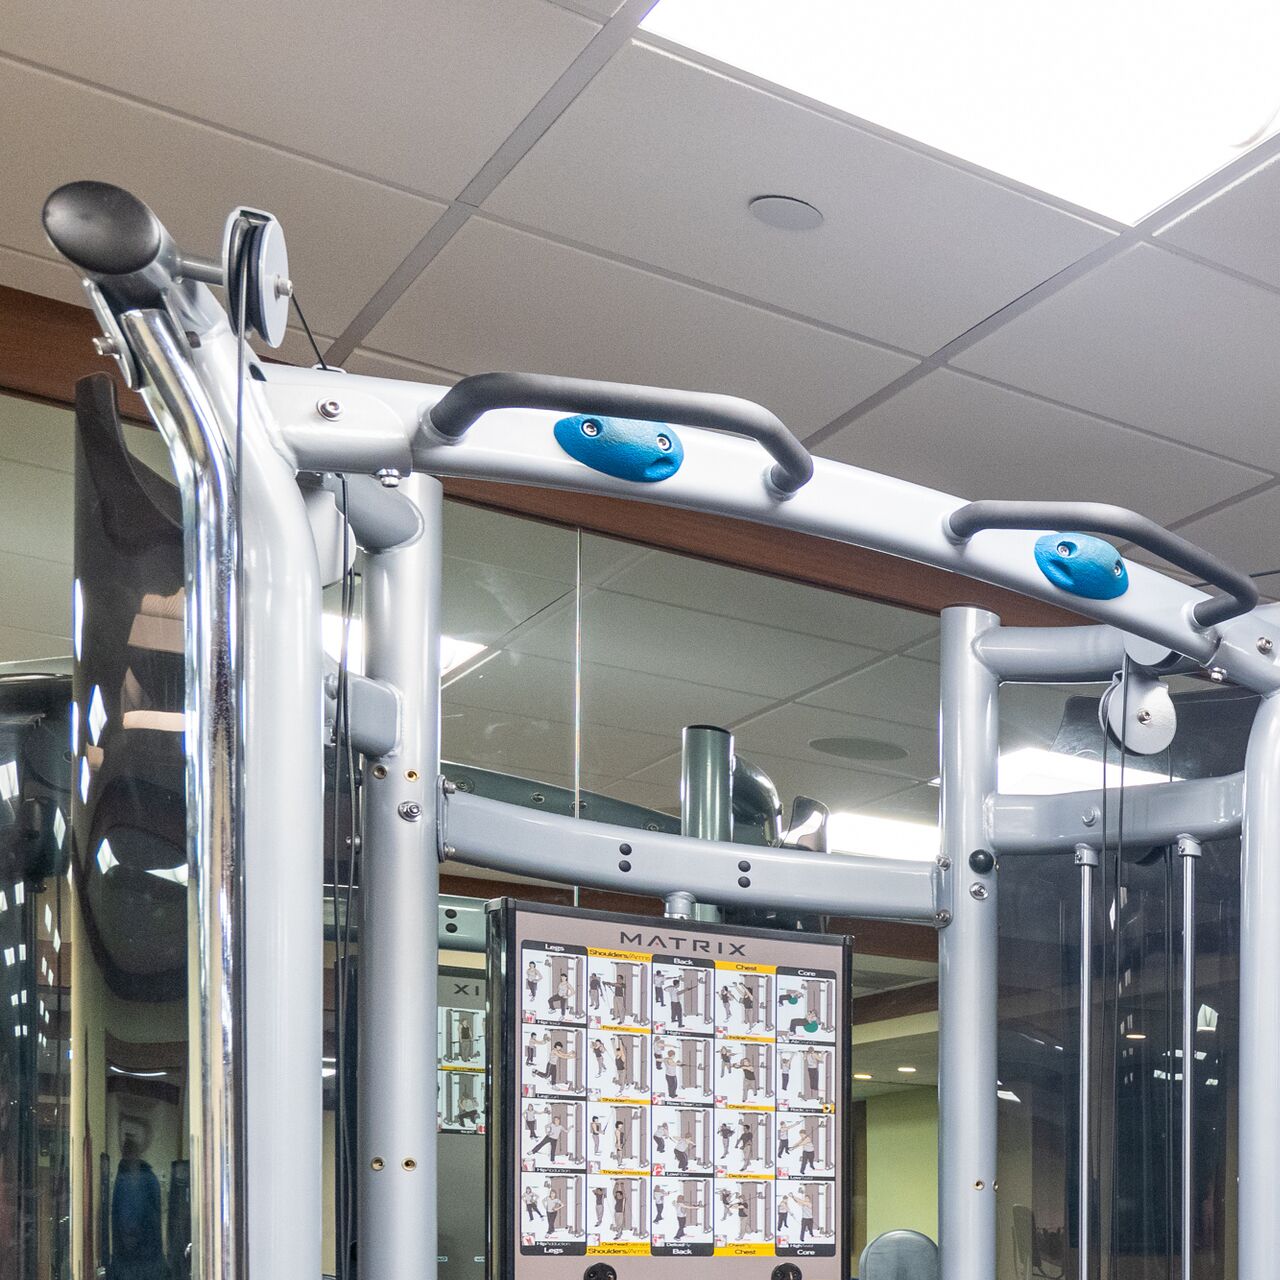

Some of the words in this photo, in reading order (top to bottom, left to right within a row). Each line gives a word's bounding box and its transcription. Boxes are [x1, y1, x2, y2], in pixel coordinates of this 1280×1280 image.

[544, 943, 565, 952] Legs
[620, 931, 746, 957] MATRIX
[673, 957, 694, 966] Back
[735, 963, 757, 971] Chest
[797, 969, 817, 977] Core
